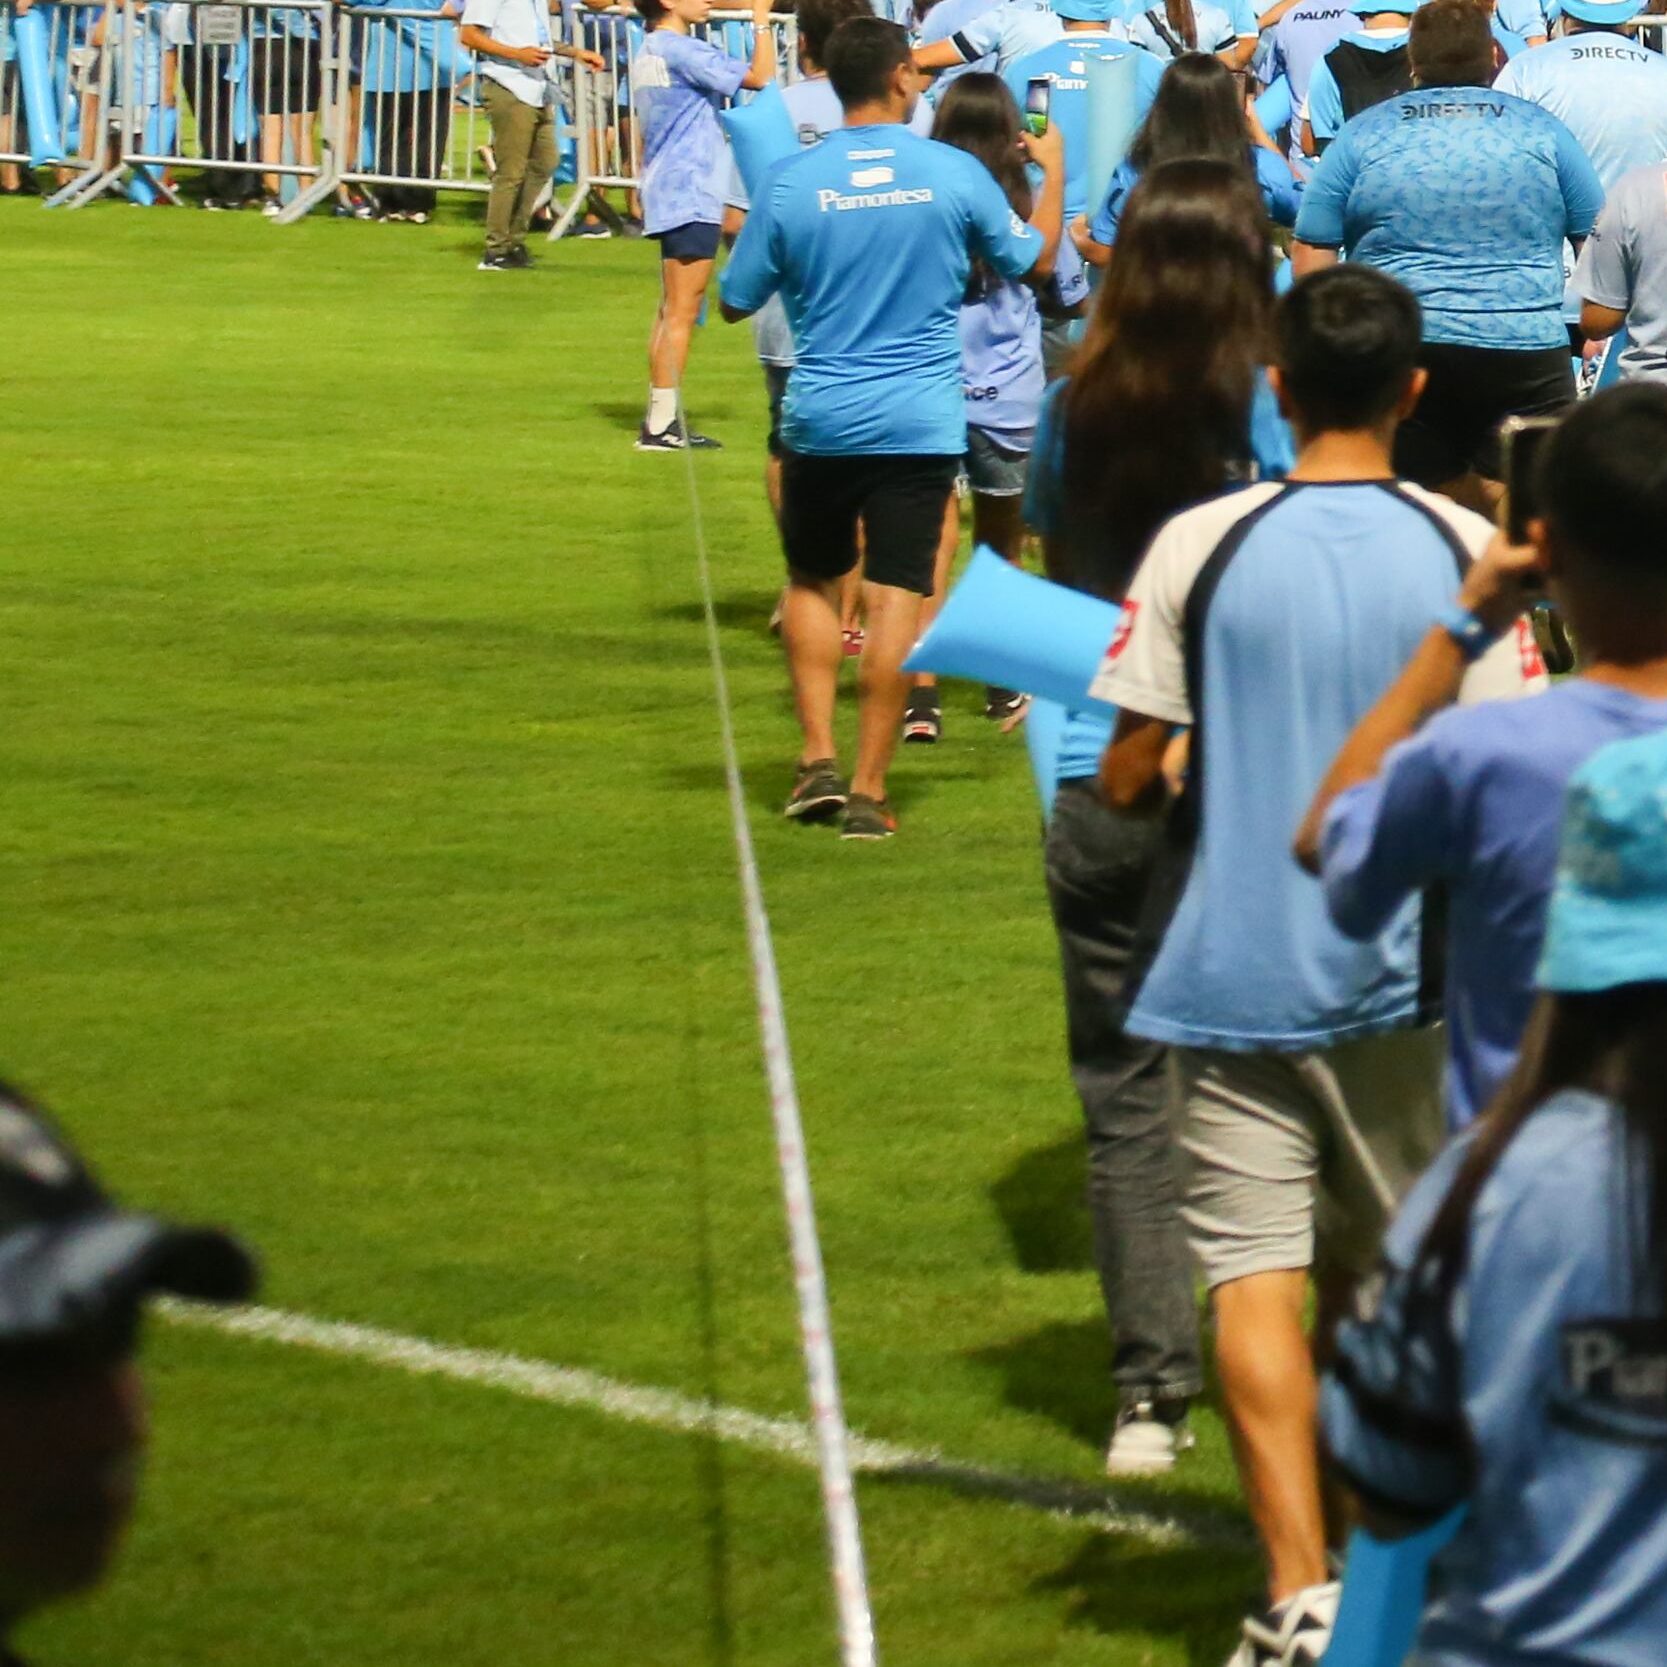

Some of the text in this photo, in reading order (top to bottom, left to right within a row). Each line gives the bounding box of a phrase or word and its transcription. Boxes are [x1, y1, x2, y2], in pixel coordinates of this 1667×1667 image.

[1293, 8, 1346, 23] PAUNY
[1570, 46, 1650, 64] DIRECTV
[1400, 101, 1505, 121] DIRECTV
[816, 188, 933, 212] Piamontesa
